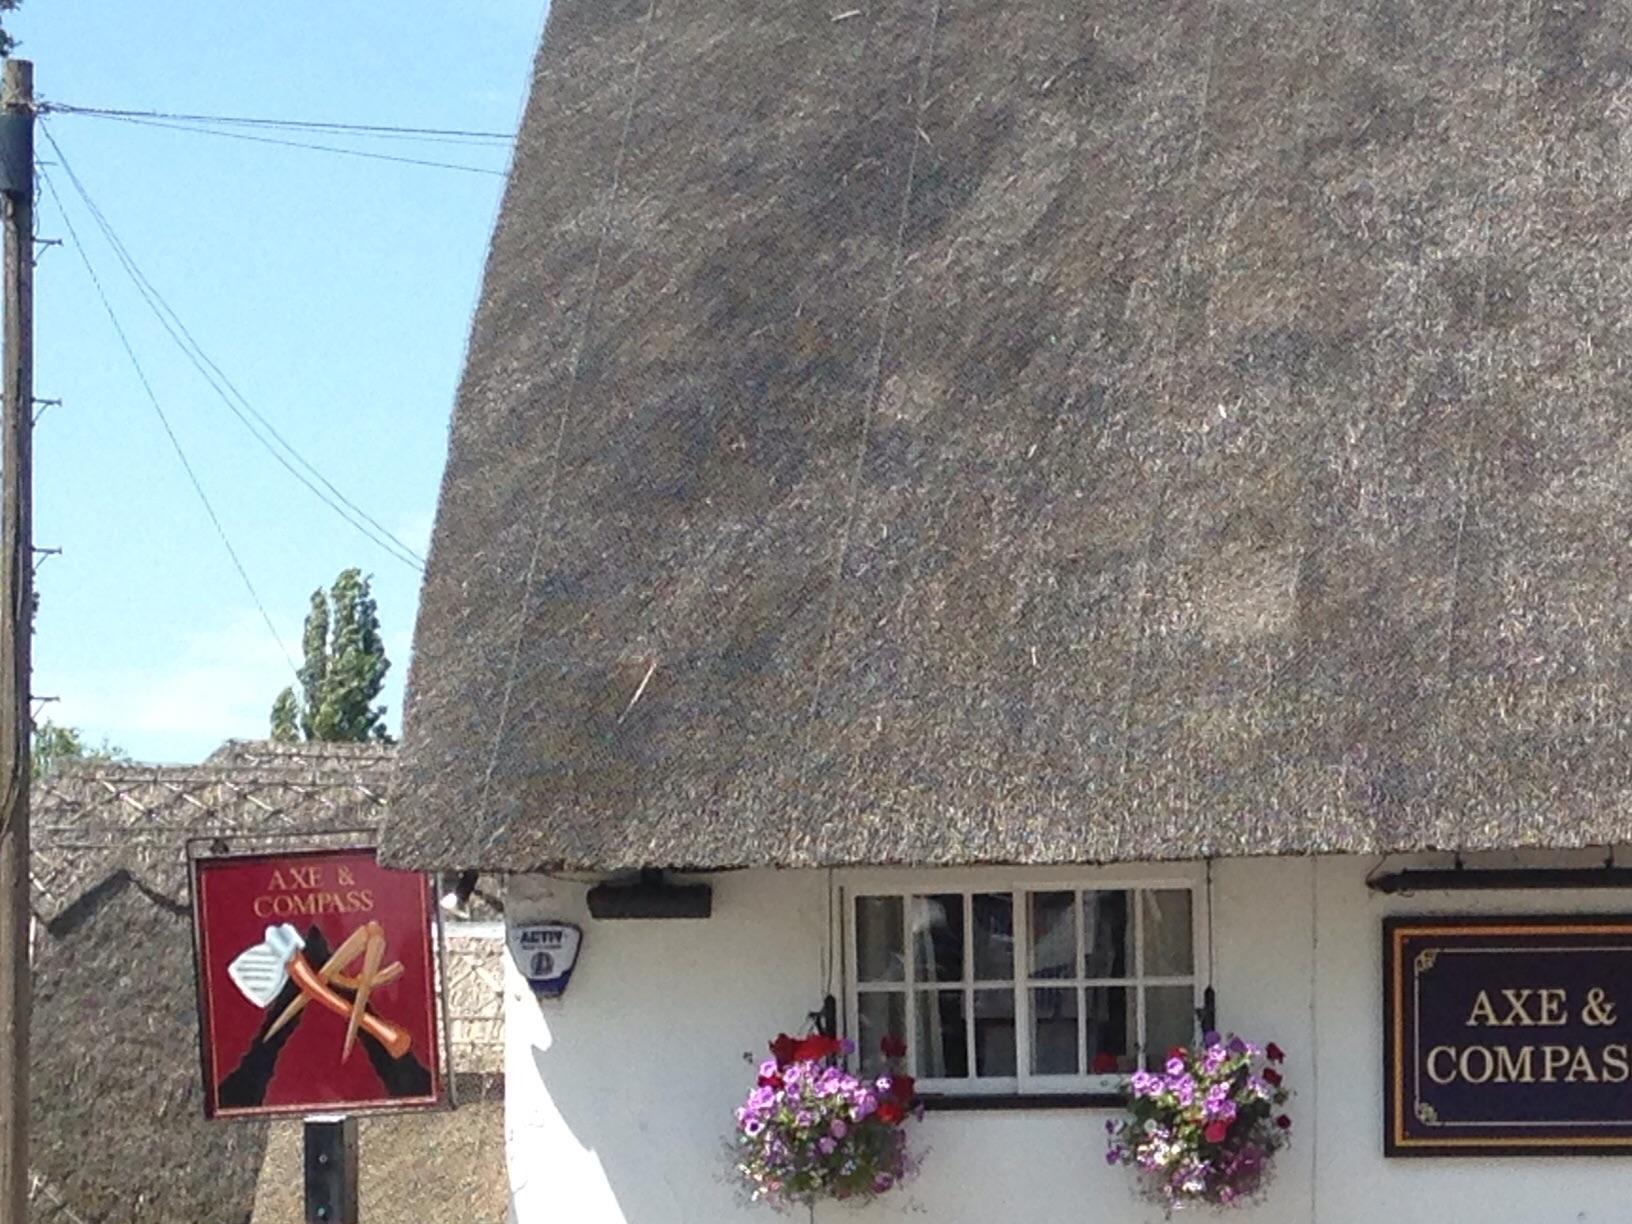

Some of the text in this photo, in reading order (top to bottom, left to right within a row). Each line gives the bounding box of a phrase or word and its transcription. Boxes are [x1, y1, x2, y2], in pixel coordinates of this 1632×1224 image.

[268, 865, 355, 891] AXE &
[254, 889, 374, 918] COMPASS
[1466, 987, 1617, 1026] AXE &
